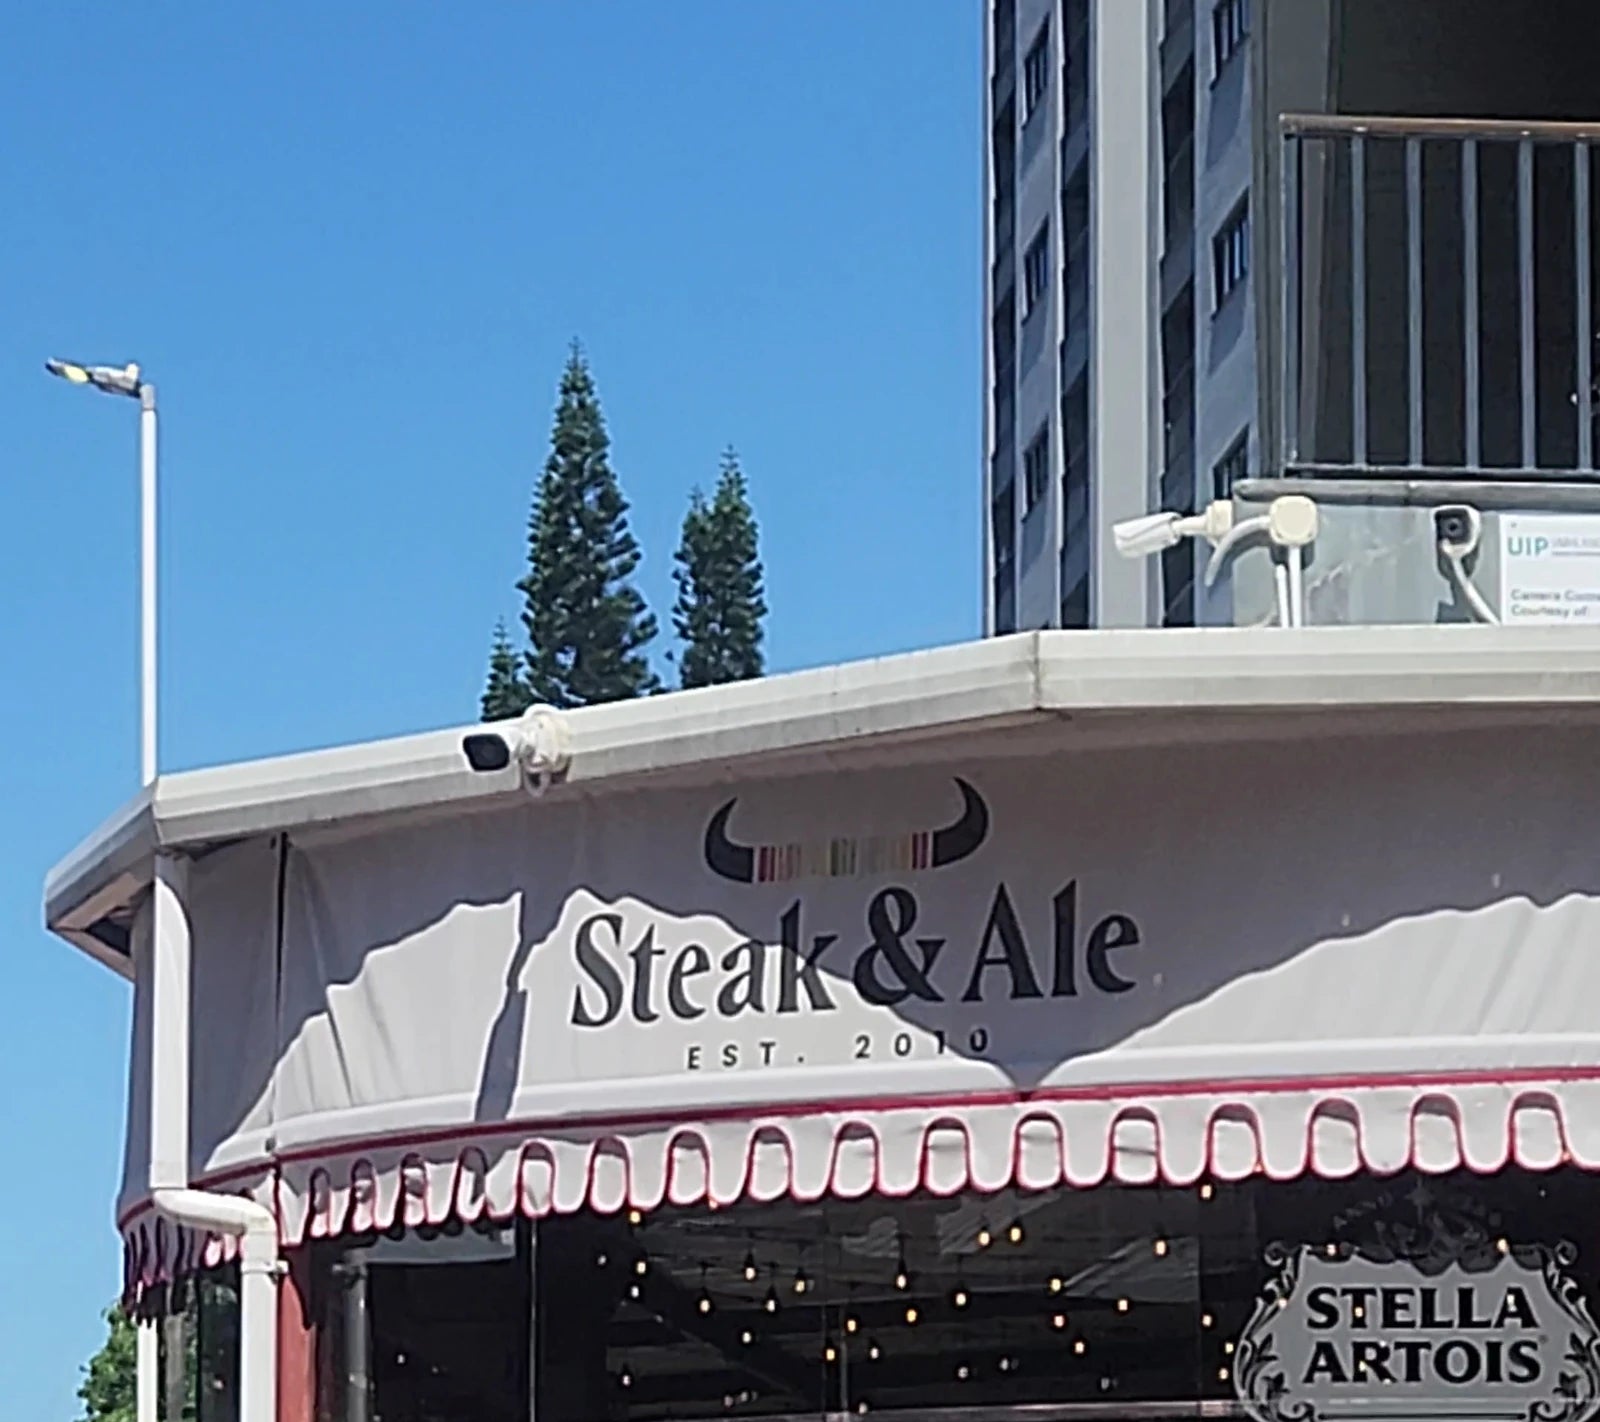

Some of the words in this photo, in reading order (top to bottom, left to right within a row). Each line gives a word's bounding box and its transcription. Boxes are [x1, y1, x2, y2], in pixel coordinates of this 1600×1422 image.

[1508, 536, 1549, 556] UIP
[571, 899, 839, 1028] Steak
[853, 887, 946, 1002] &
[961, 878, 1139, 1002] Ale
[687, 1040, 804, 1070] EST.
[855, 1028, 988, 1059] 2010
[1306, 1286, 1540, 1330] STELLA
[1303, 1340, 1542, 1384] ARTOIS
